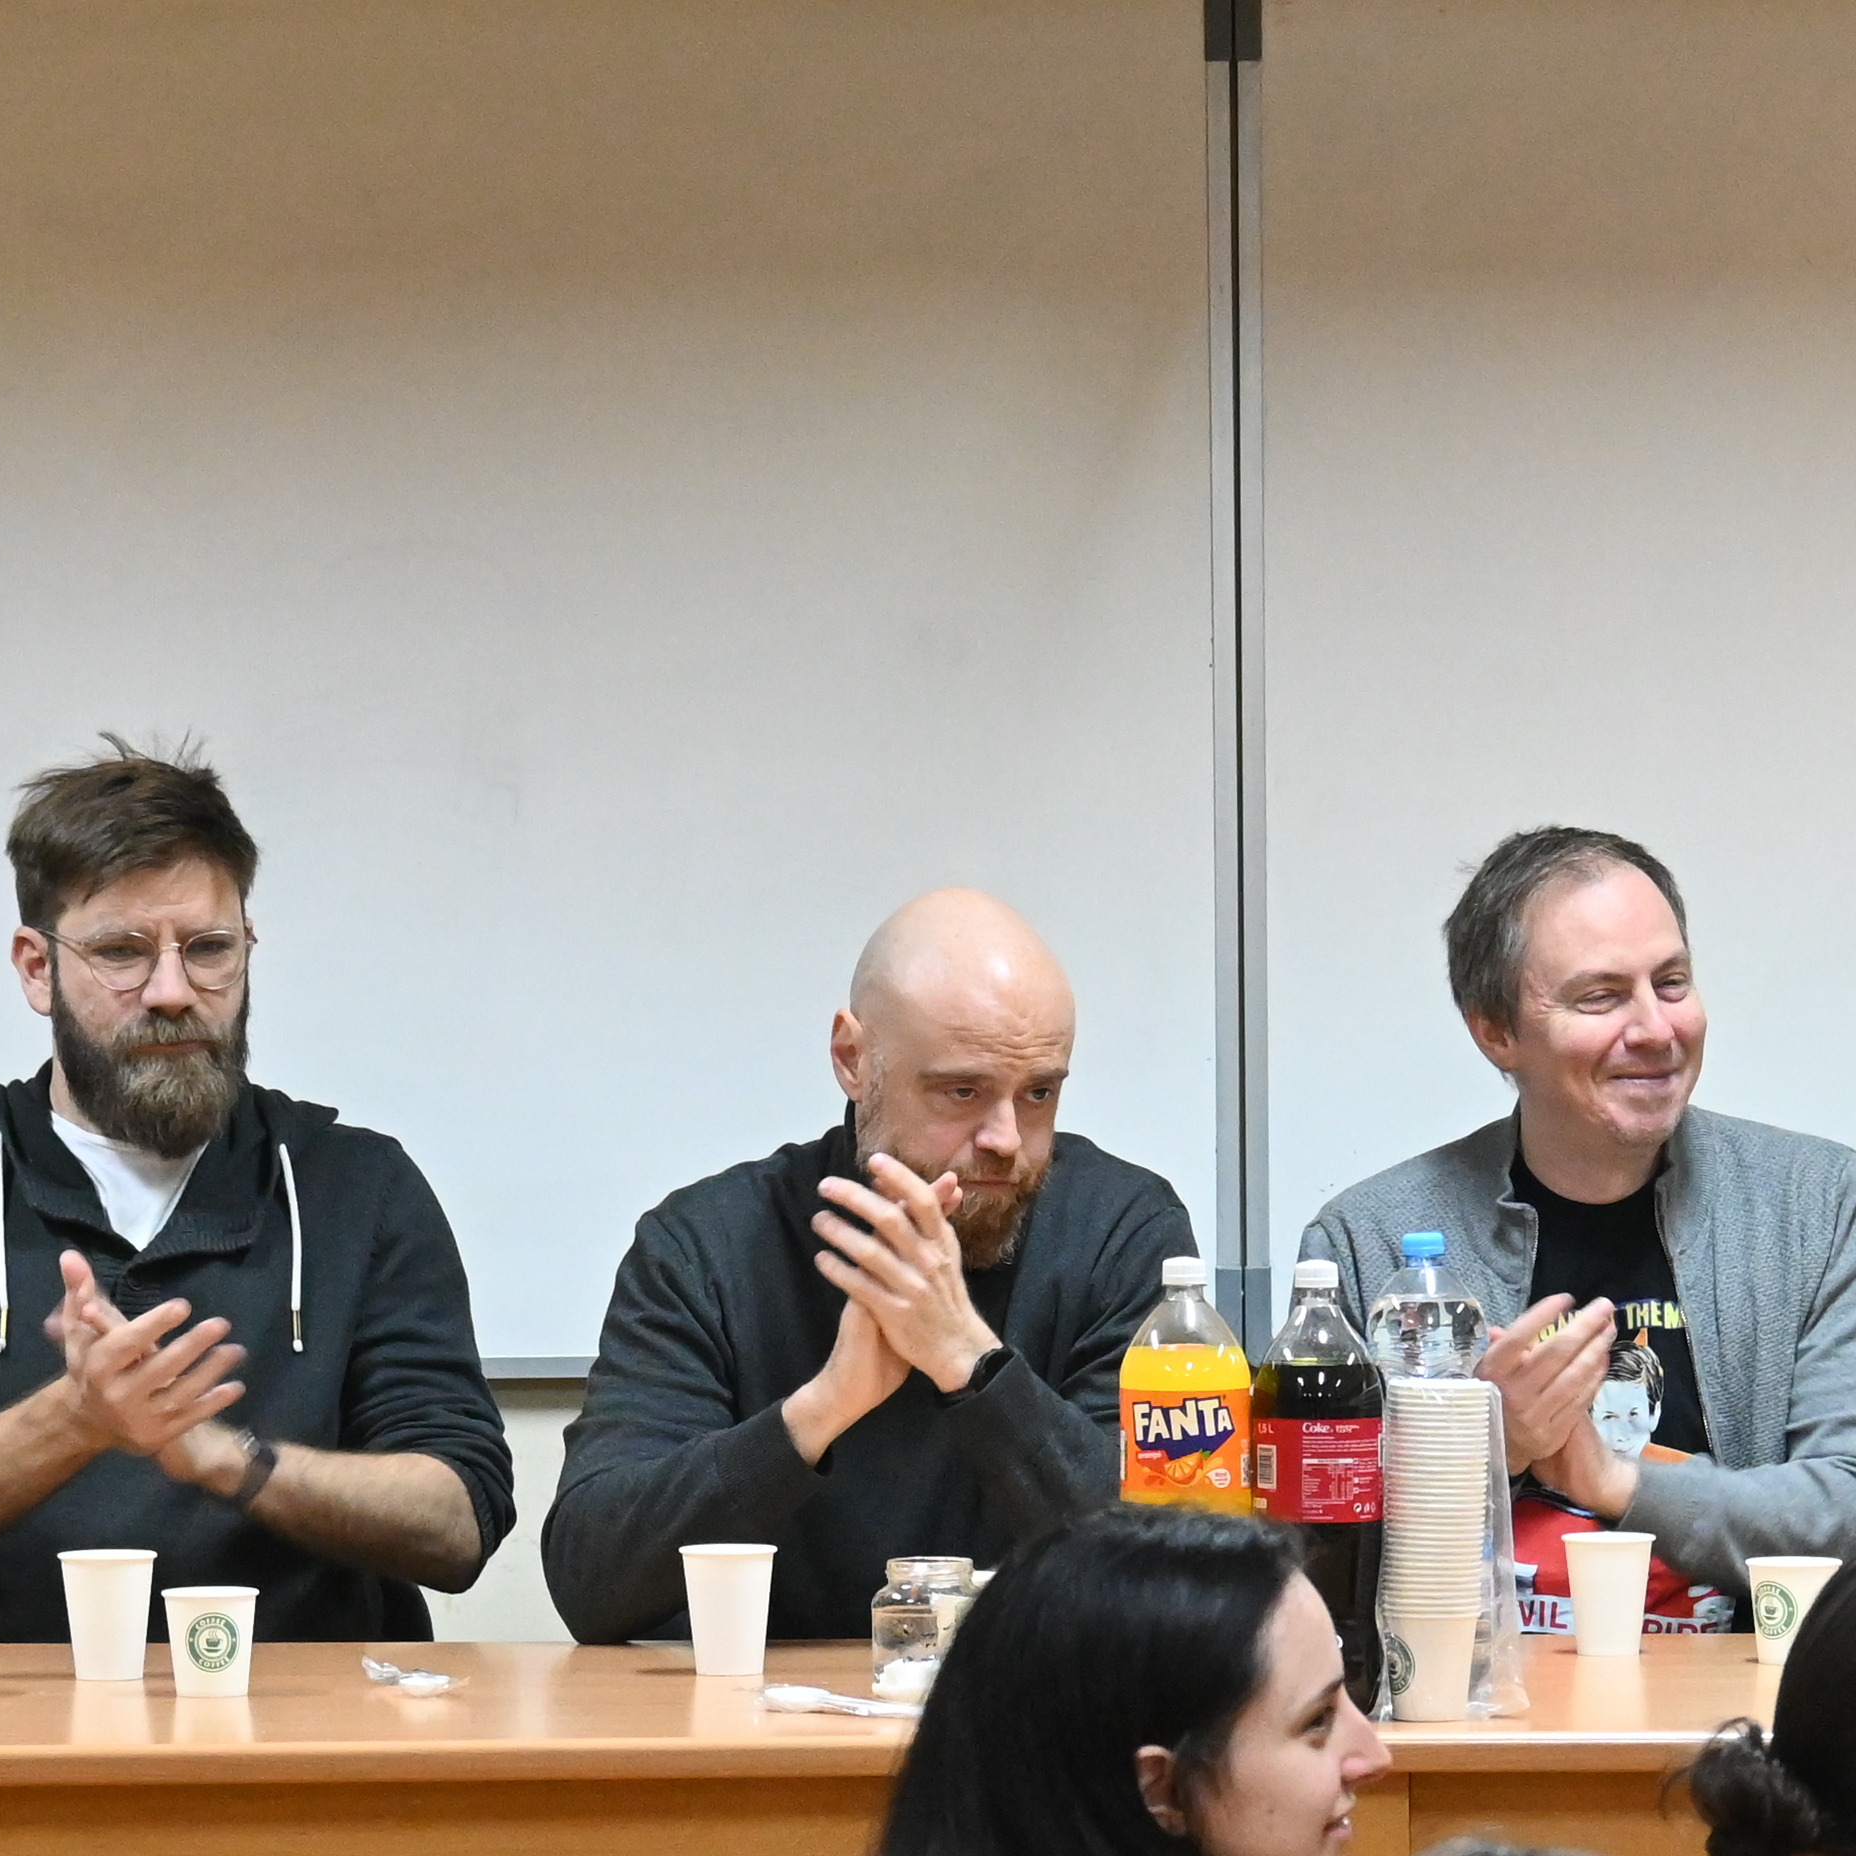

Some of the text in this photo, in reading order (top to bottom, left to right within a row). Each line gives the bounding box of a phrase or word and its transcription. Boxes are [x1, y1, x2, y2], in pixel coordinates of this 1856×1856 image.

[1625, 1300, 1682, 1329] THEM
[1132, 1399, 1233, 1443] FANTA
[1302, 1422, 1330, 1434] Coke
[195, 1617, 226, 1630] COFFEE
[198, 1655, 230, 1669] COFFEE
